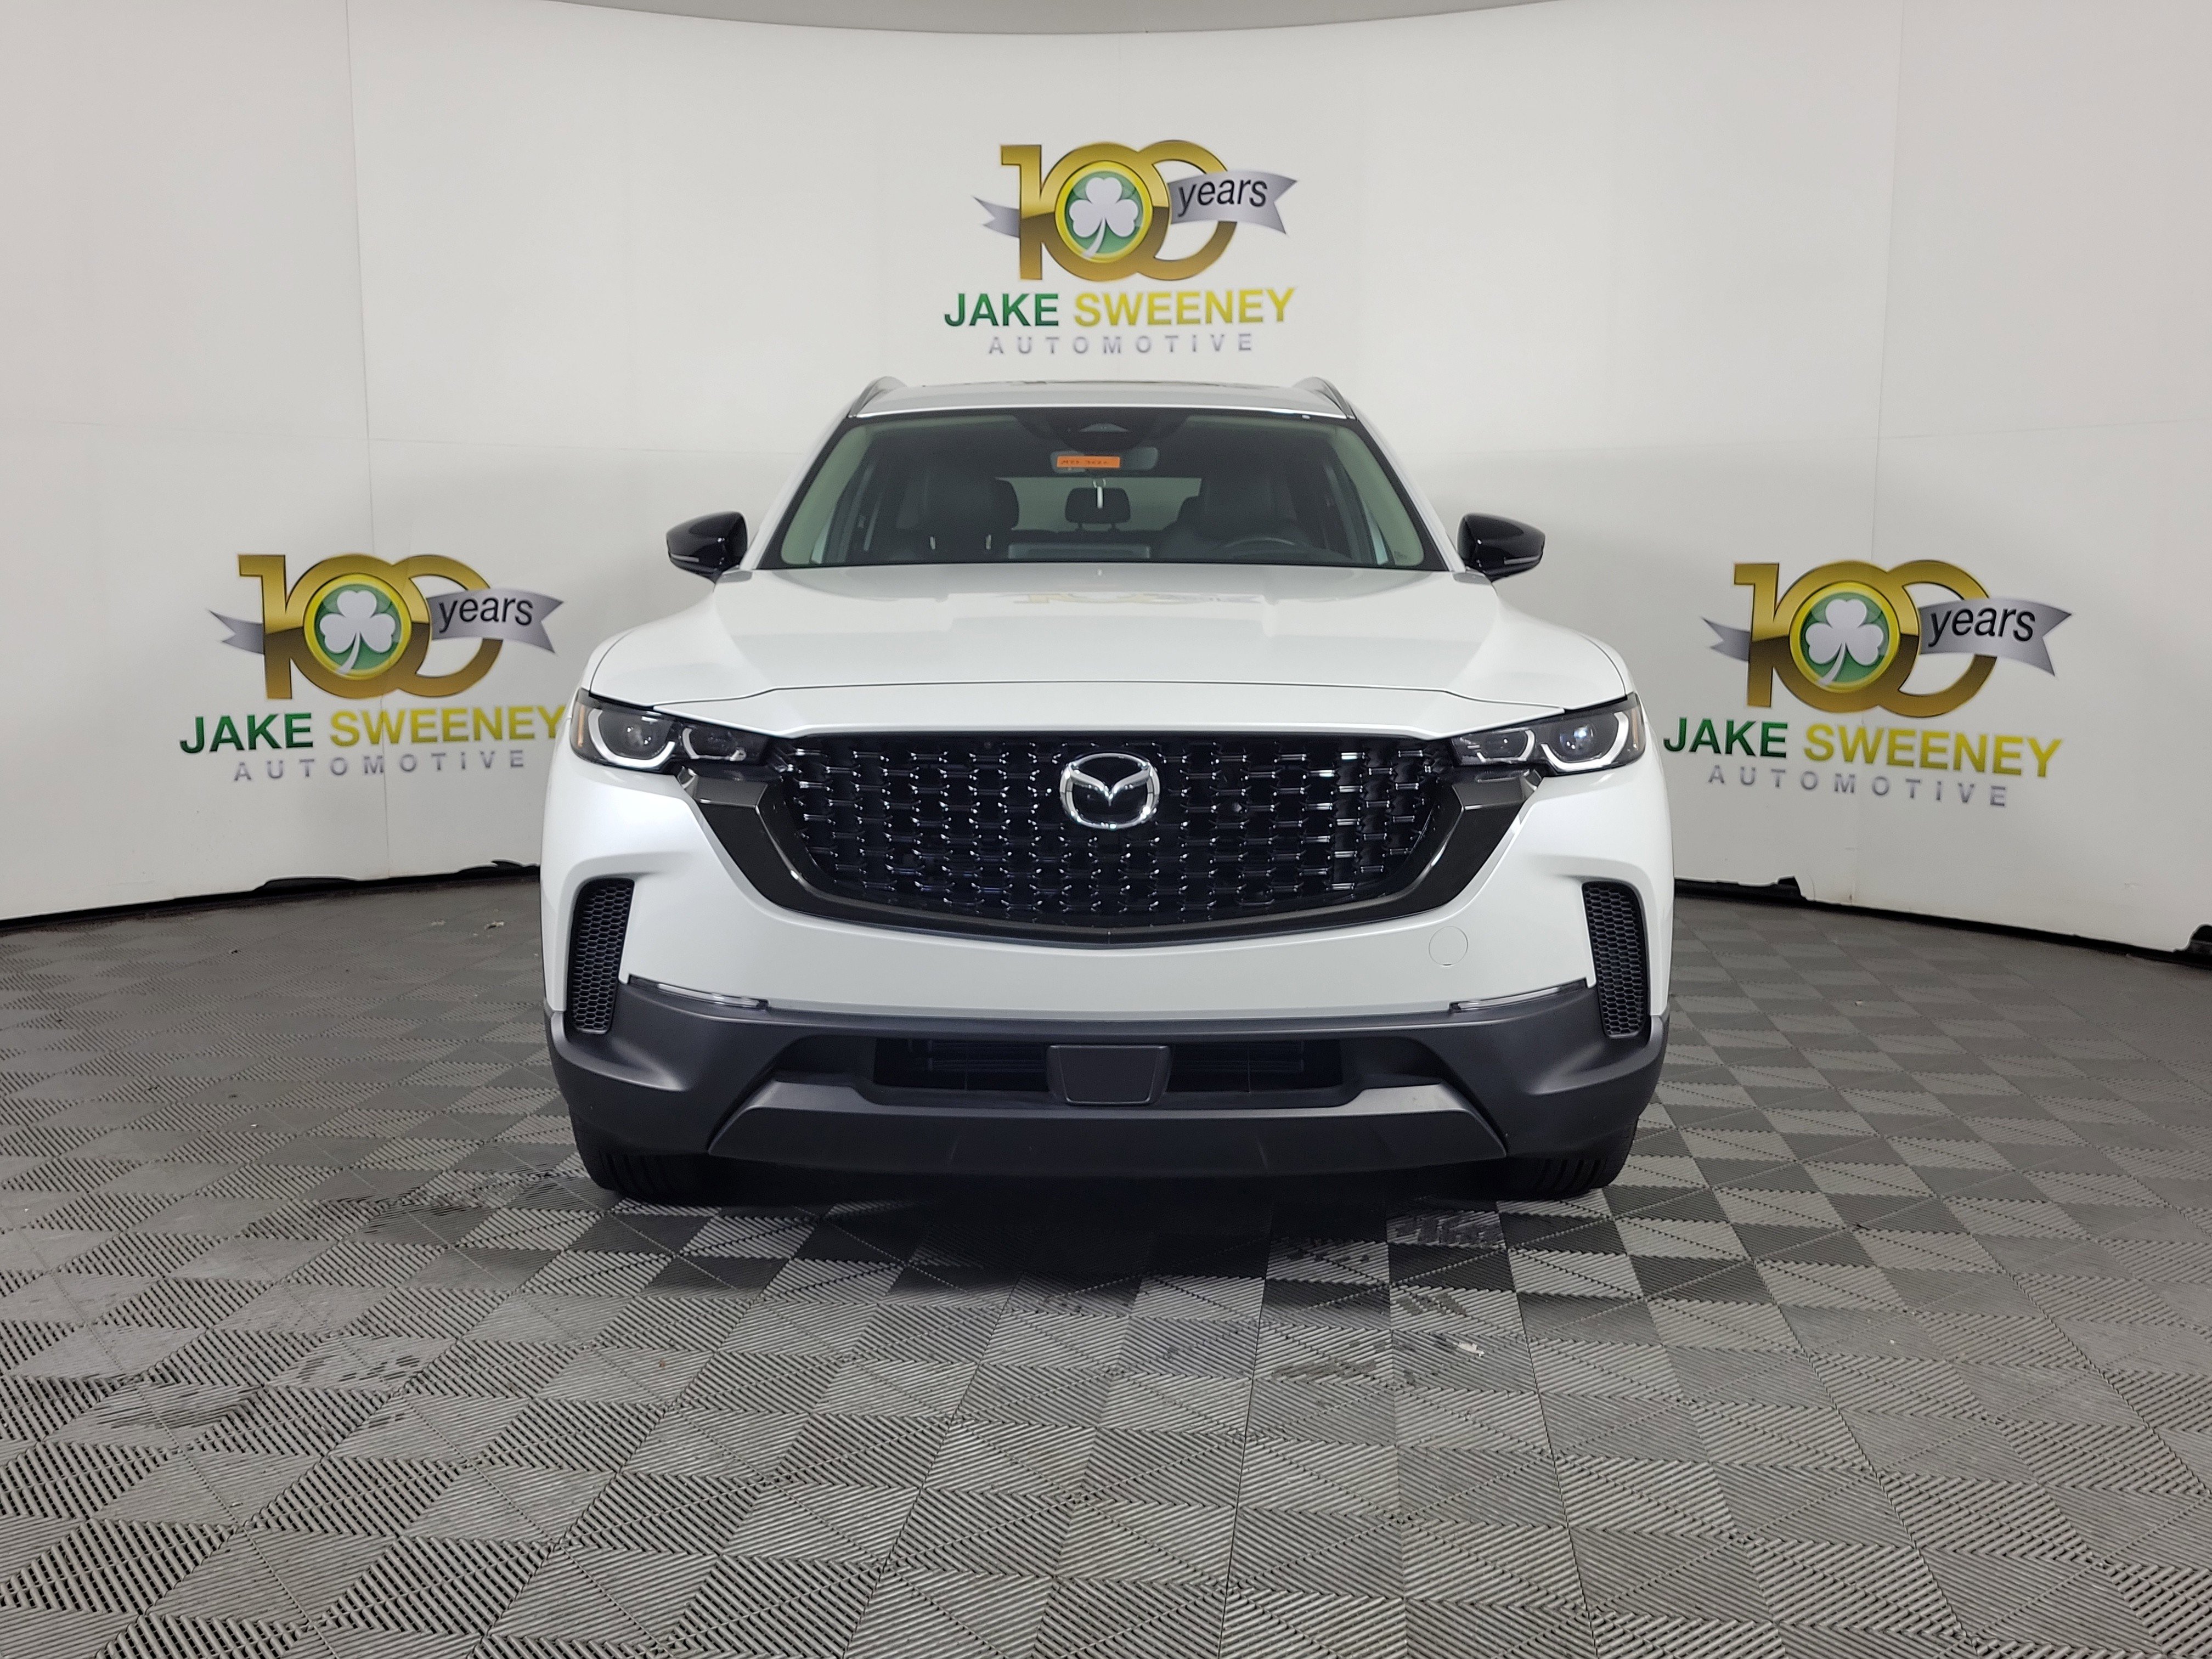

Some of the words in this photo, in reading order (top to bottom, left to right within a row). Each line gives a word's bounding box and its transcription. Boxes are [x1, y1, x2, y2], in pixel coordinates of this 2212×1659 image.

[1178, 178, 1267, 217] years
[944, 293, 1059, 327] JAKE
[1074, 287, 1296, 327] SWEENEY
[989, 333, 1252, 354] AUTOMOTIVE
[439, 597, 534, 633] years
[1928, 607, 2036, 647] years
[179, 713, 313, 754] JAKE
[330, 705, 566, 747] SWEENEY
[1663, 718, 1788, 759] JAKE
[1803, 724, 2062, 778] SWEENEY
[234, 750, 524, 782] AUTOMOTIVE
[1708, 765, 2006, 806] AUTOMOTIVE
